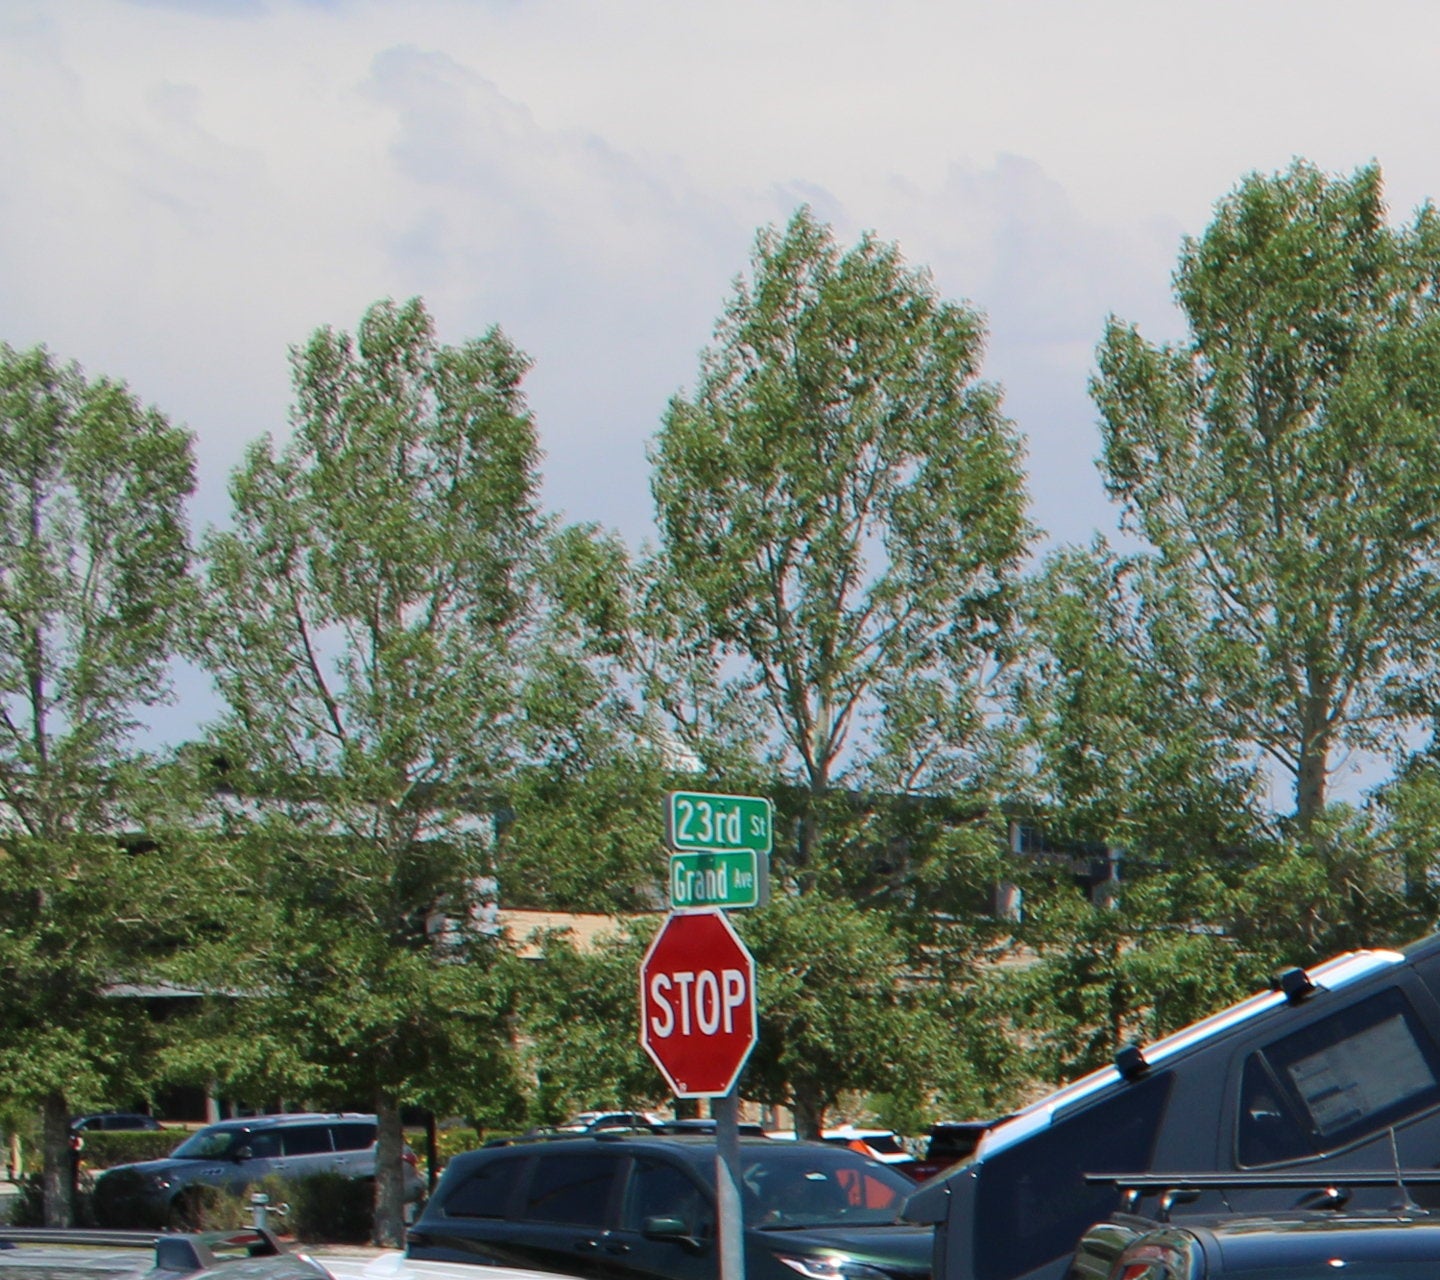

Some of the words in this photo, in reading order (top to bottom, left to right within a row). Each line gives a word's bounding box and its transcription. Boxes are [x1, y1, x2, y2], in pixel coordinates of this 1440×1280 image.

[677, 799, 741, 844] 23rd
[750, 814, 767, 837] St
[673, 860, 728, 902] Grand
[733, 867, 753, 889] Ave
[650, 968, 746, 1039] STOP
